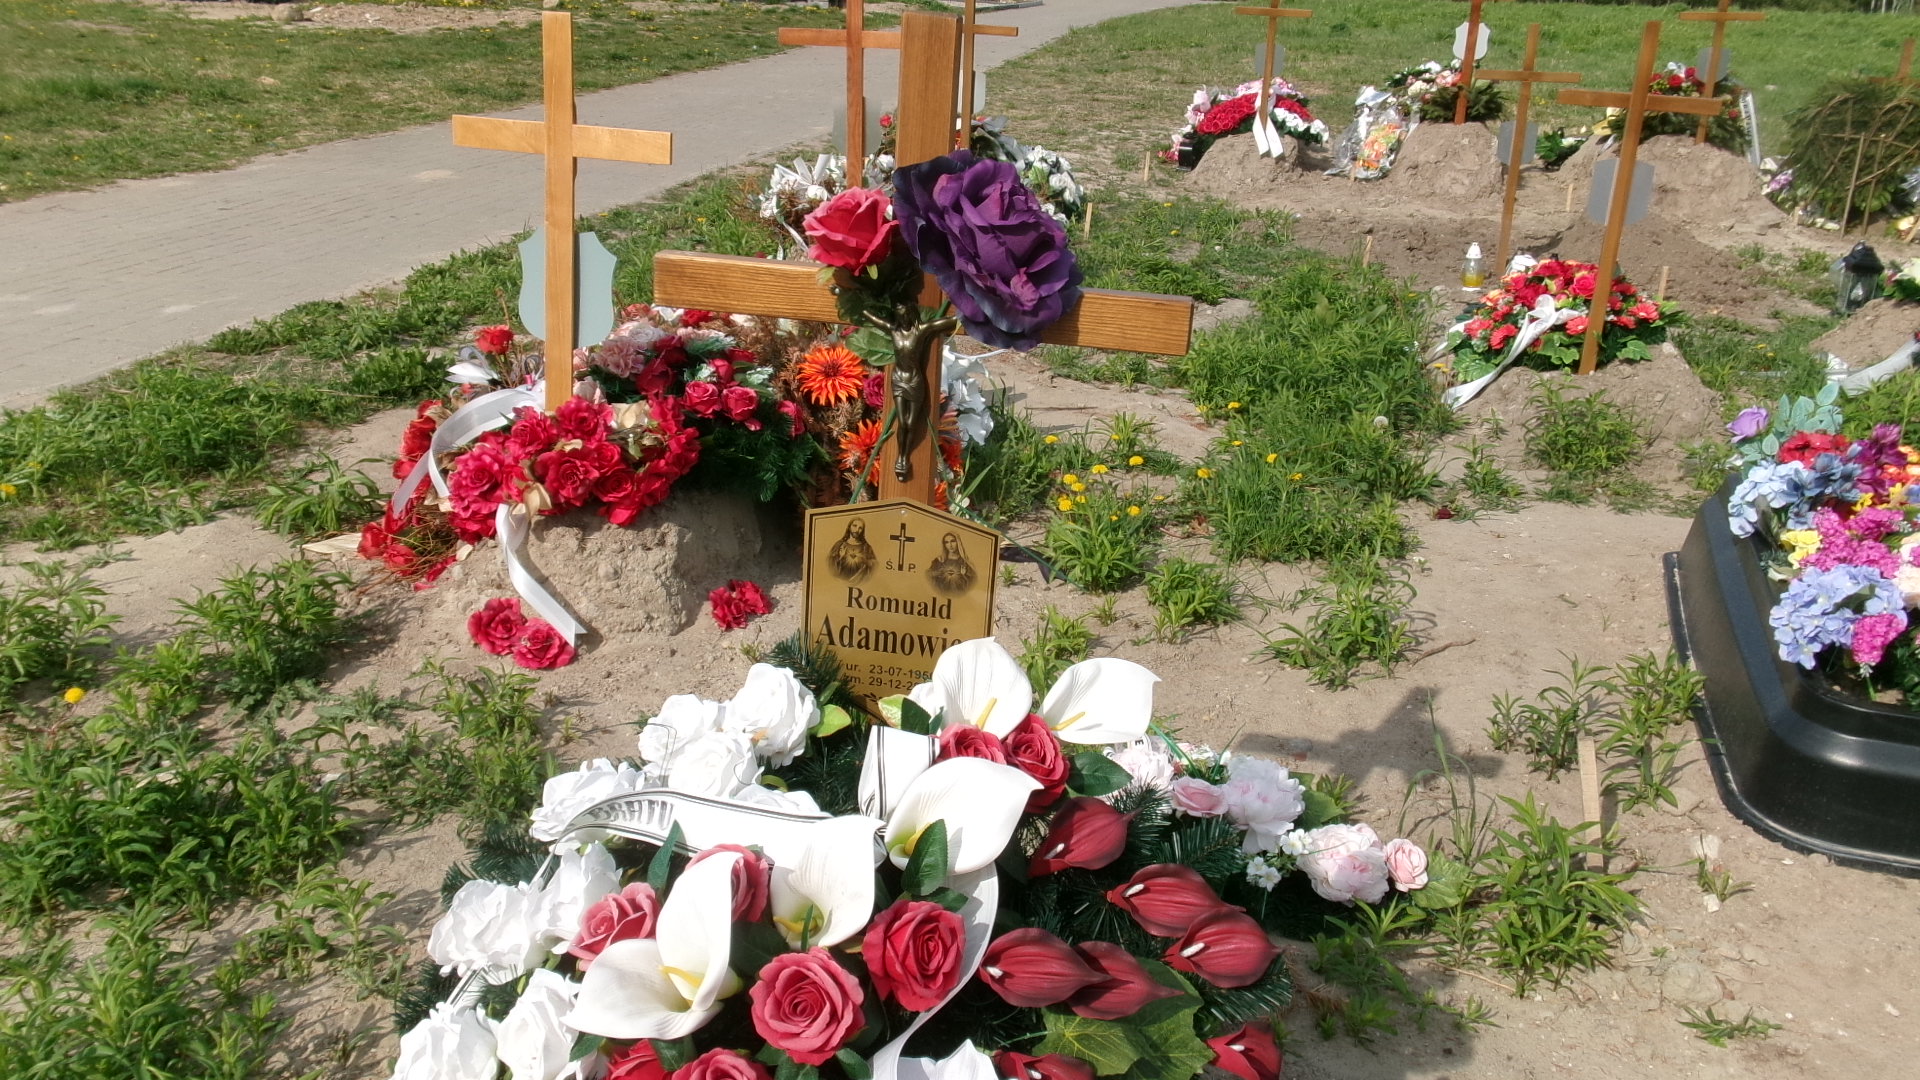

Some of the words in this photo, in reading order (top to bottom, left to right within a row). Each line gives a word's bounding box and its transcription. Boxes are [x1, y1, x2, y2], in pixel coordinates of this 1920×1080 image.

[907, 563, 917, 573] P.
[847, 586, 952, 620] Romuald
[846, 663, 861, 672] ur.
[868, 676, 921, 691] 29-12-2
